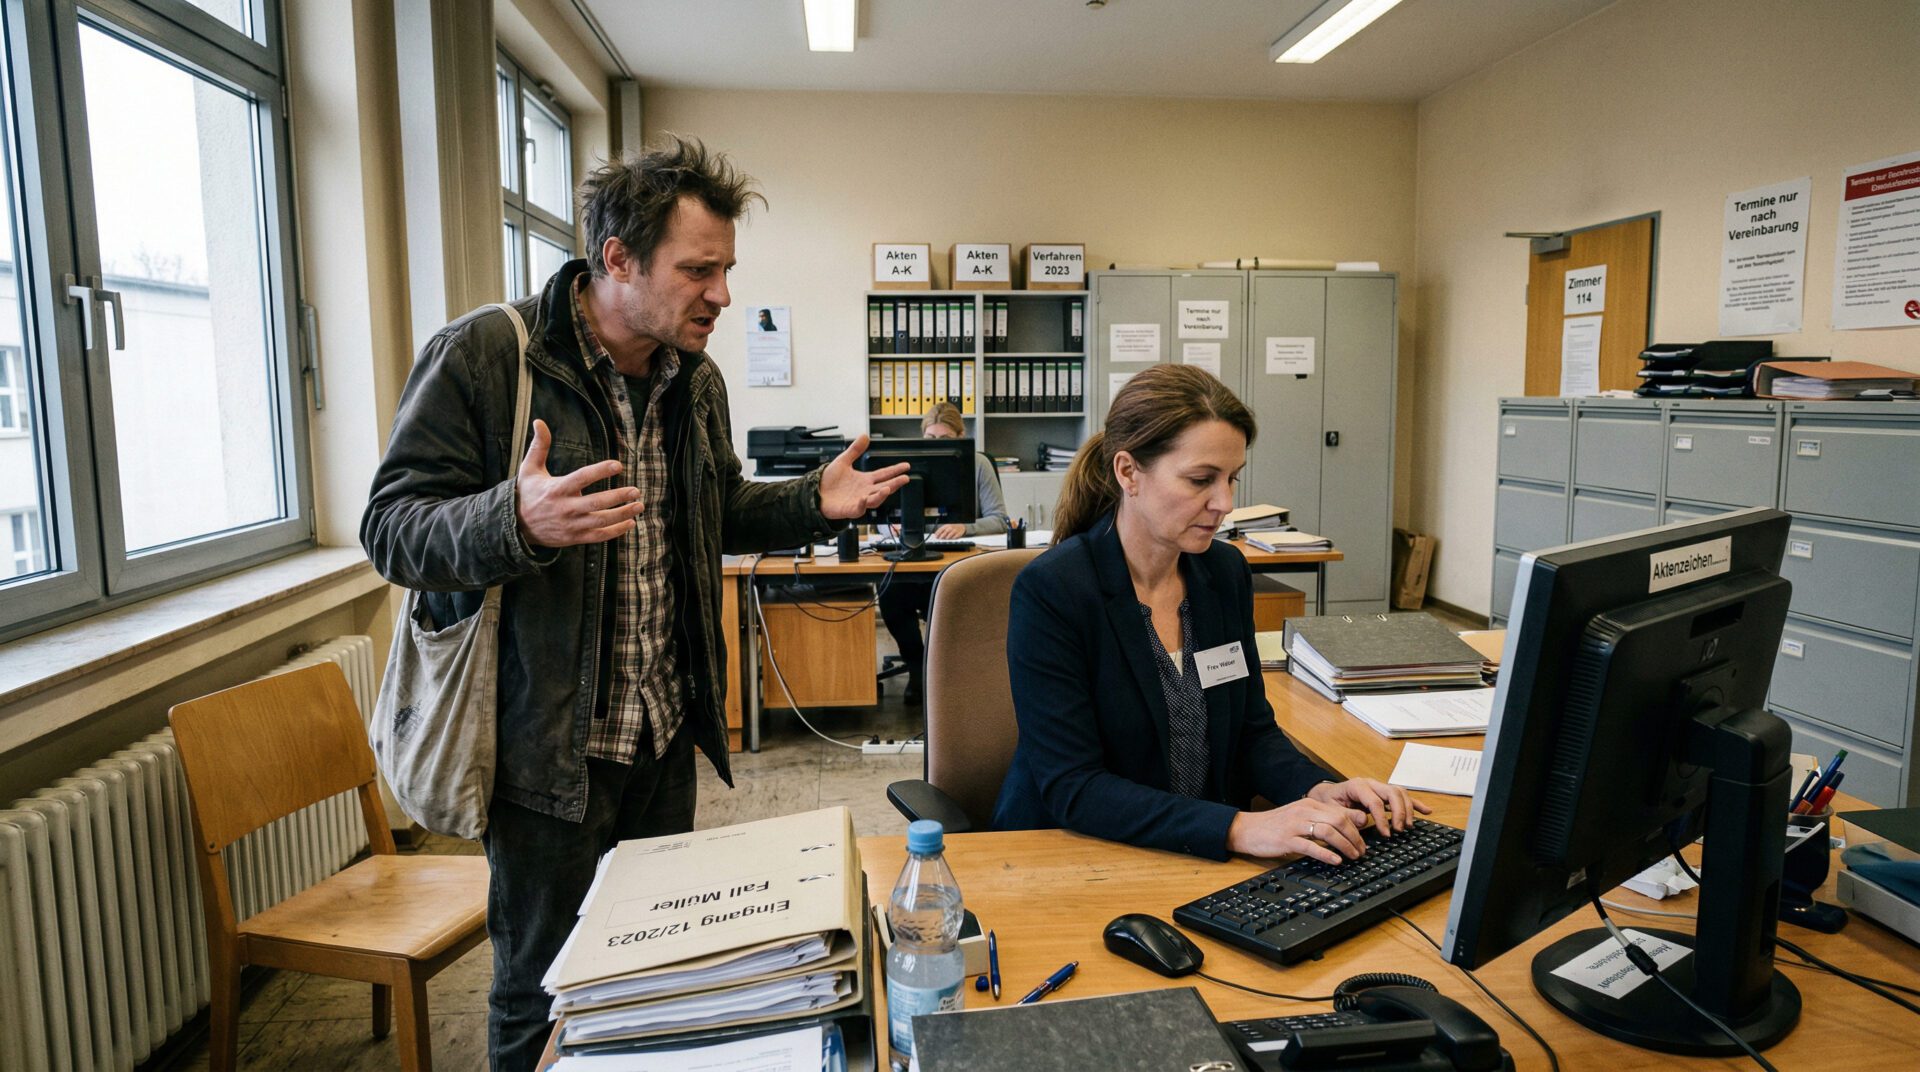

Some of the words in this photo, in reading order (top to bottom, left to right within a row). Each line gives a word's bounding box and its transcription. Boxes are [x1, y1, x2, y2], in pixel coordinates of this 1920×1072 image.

[1734, 197, 1776, 212] Termine
[1779, 192, 1798, 203] nur
[1751, 209, 1777, 223] nach
[1728, 221, 1799, 240] Vereinbarung
[886, 251, 917, 260] Akten
[967, 251, 998, 260] Akten
[1032, 251, 1082, 261] Verfahren
[892, 266, 912, 275] A-K
[972, 266, 993, 275] A-K
[1044, 266, 1071, 275] 2023
[1568, 276, 1602, 290] Zimmer
[1577, 292, 1592, 304] 114
[1652, 553, 1713, 580] Aktenzeichen
[729, 880, 770, 899] Fall
[650, 890, 721, 911] Müller
[700, 900, 790, 926] Eingang
[608, 916, 691, 947] 12/2023
